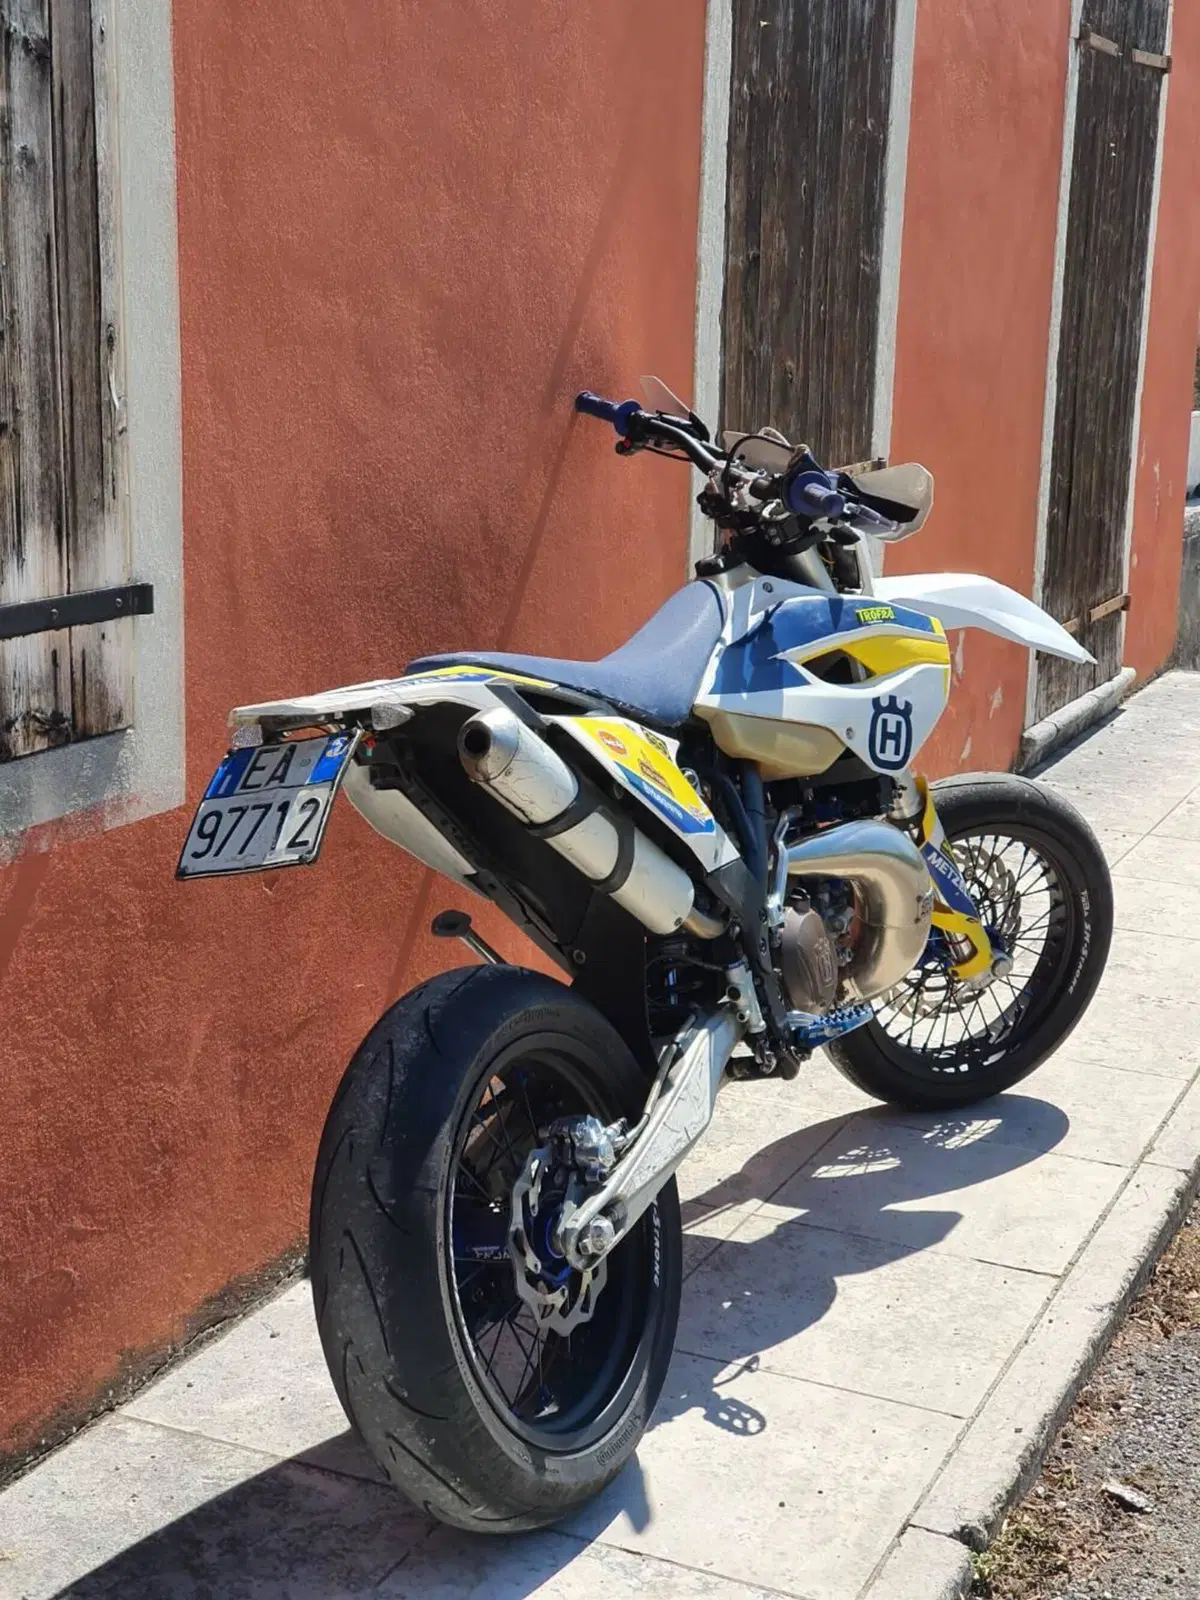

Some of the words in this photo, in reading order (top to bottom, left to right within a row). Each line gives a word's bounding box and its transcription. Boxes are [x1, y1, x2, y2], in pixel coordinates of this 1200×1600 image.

[880, 717, 903, 756] H
[239, 744, 297, 790] EA
[191, 797, 321, 860] 97712
